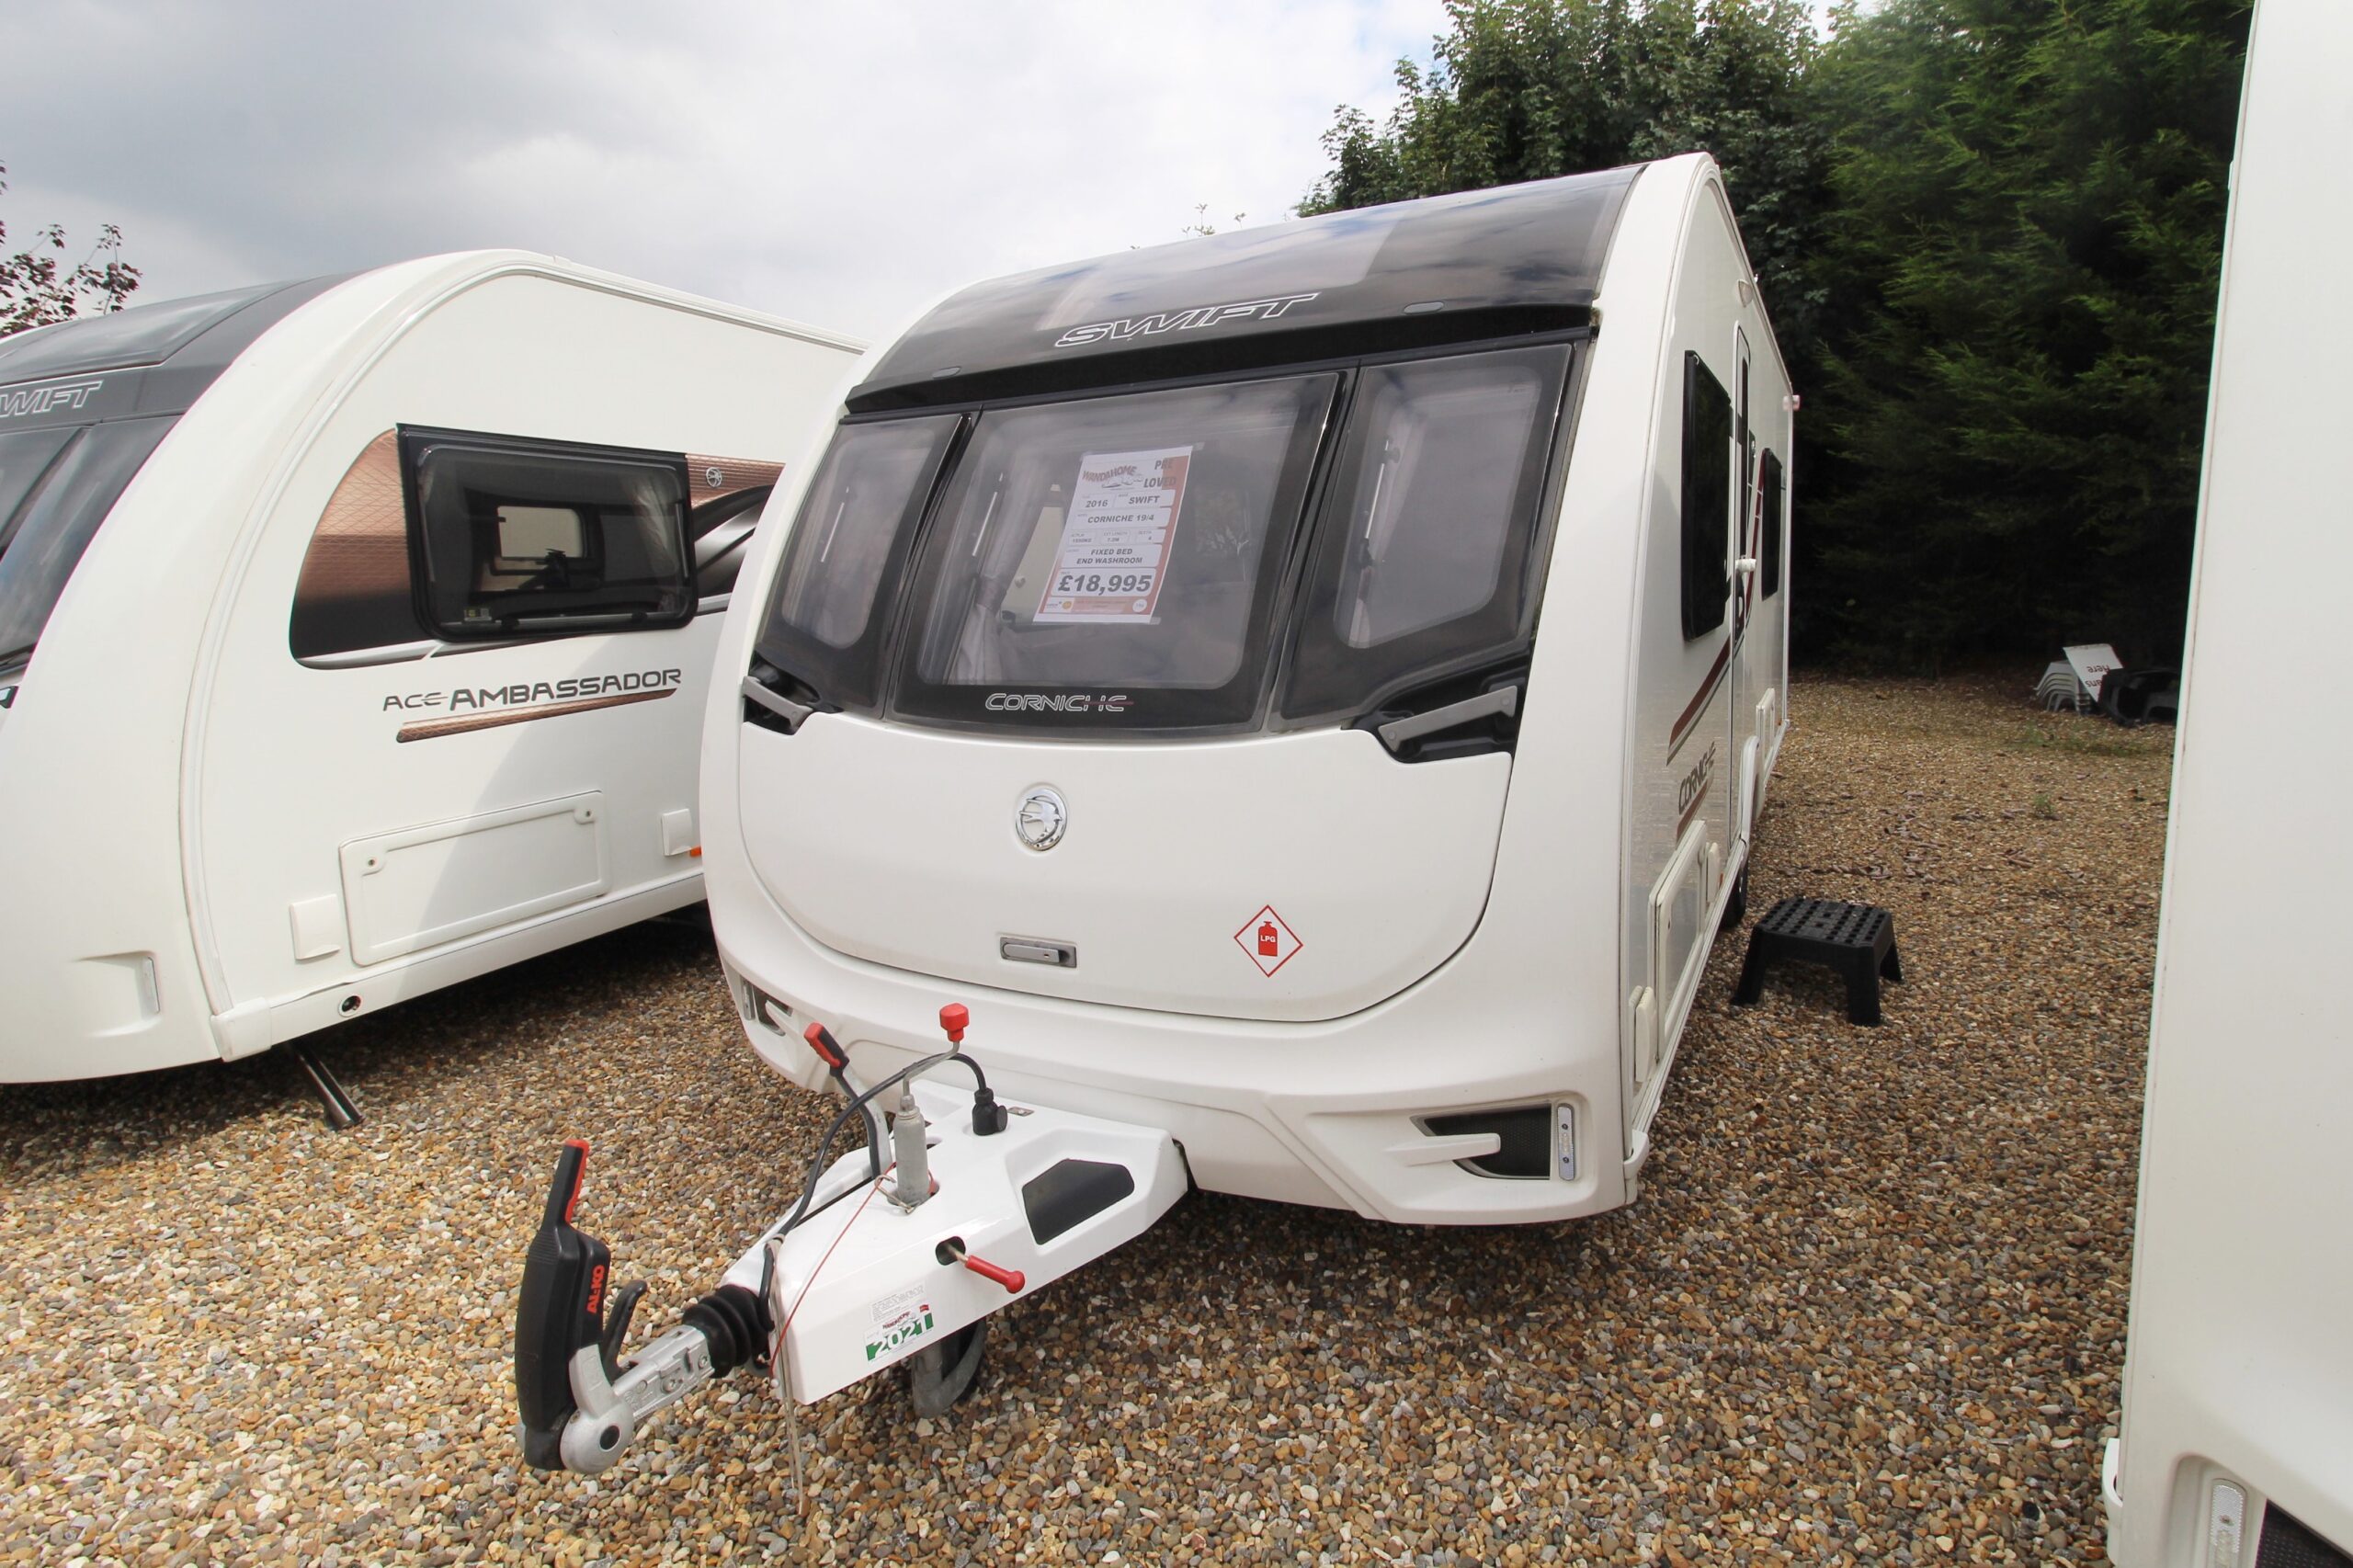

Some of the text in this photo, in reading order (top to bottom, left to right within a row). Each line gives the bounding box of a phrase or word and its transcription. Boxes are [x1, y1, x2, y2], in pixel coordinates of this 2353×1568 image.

[1054, 291, 1322, 347] SWIFT
[0, 380, 104, 417] WIFT
[1143, 477, 1176, 488] LOVED
[1086, 500, 1108, 508] 2016
[1129, 495, 1161, 505] SWIFT
[1087, 515, 1133, 524] CORNICHE
[1058, 574, 1152, 597] £18,995
[382, 668, 682, 711] ACE AMBASSADOR
[1260, 935, 1276, 943] LPG
[872, 1312, 927, 1360] 2021
